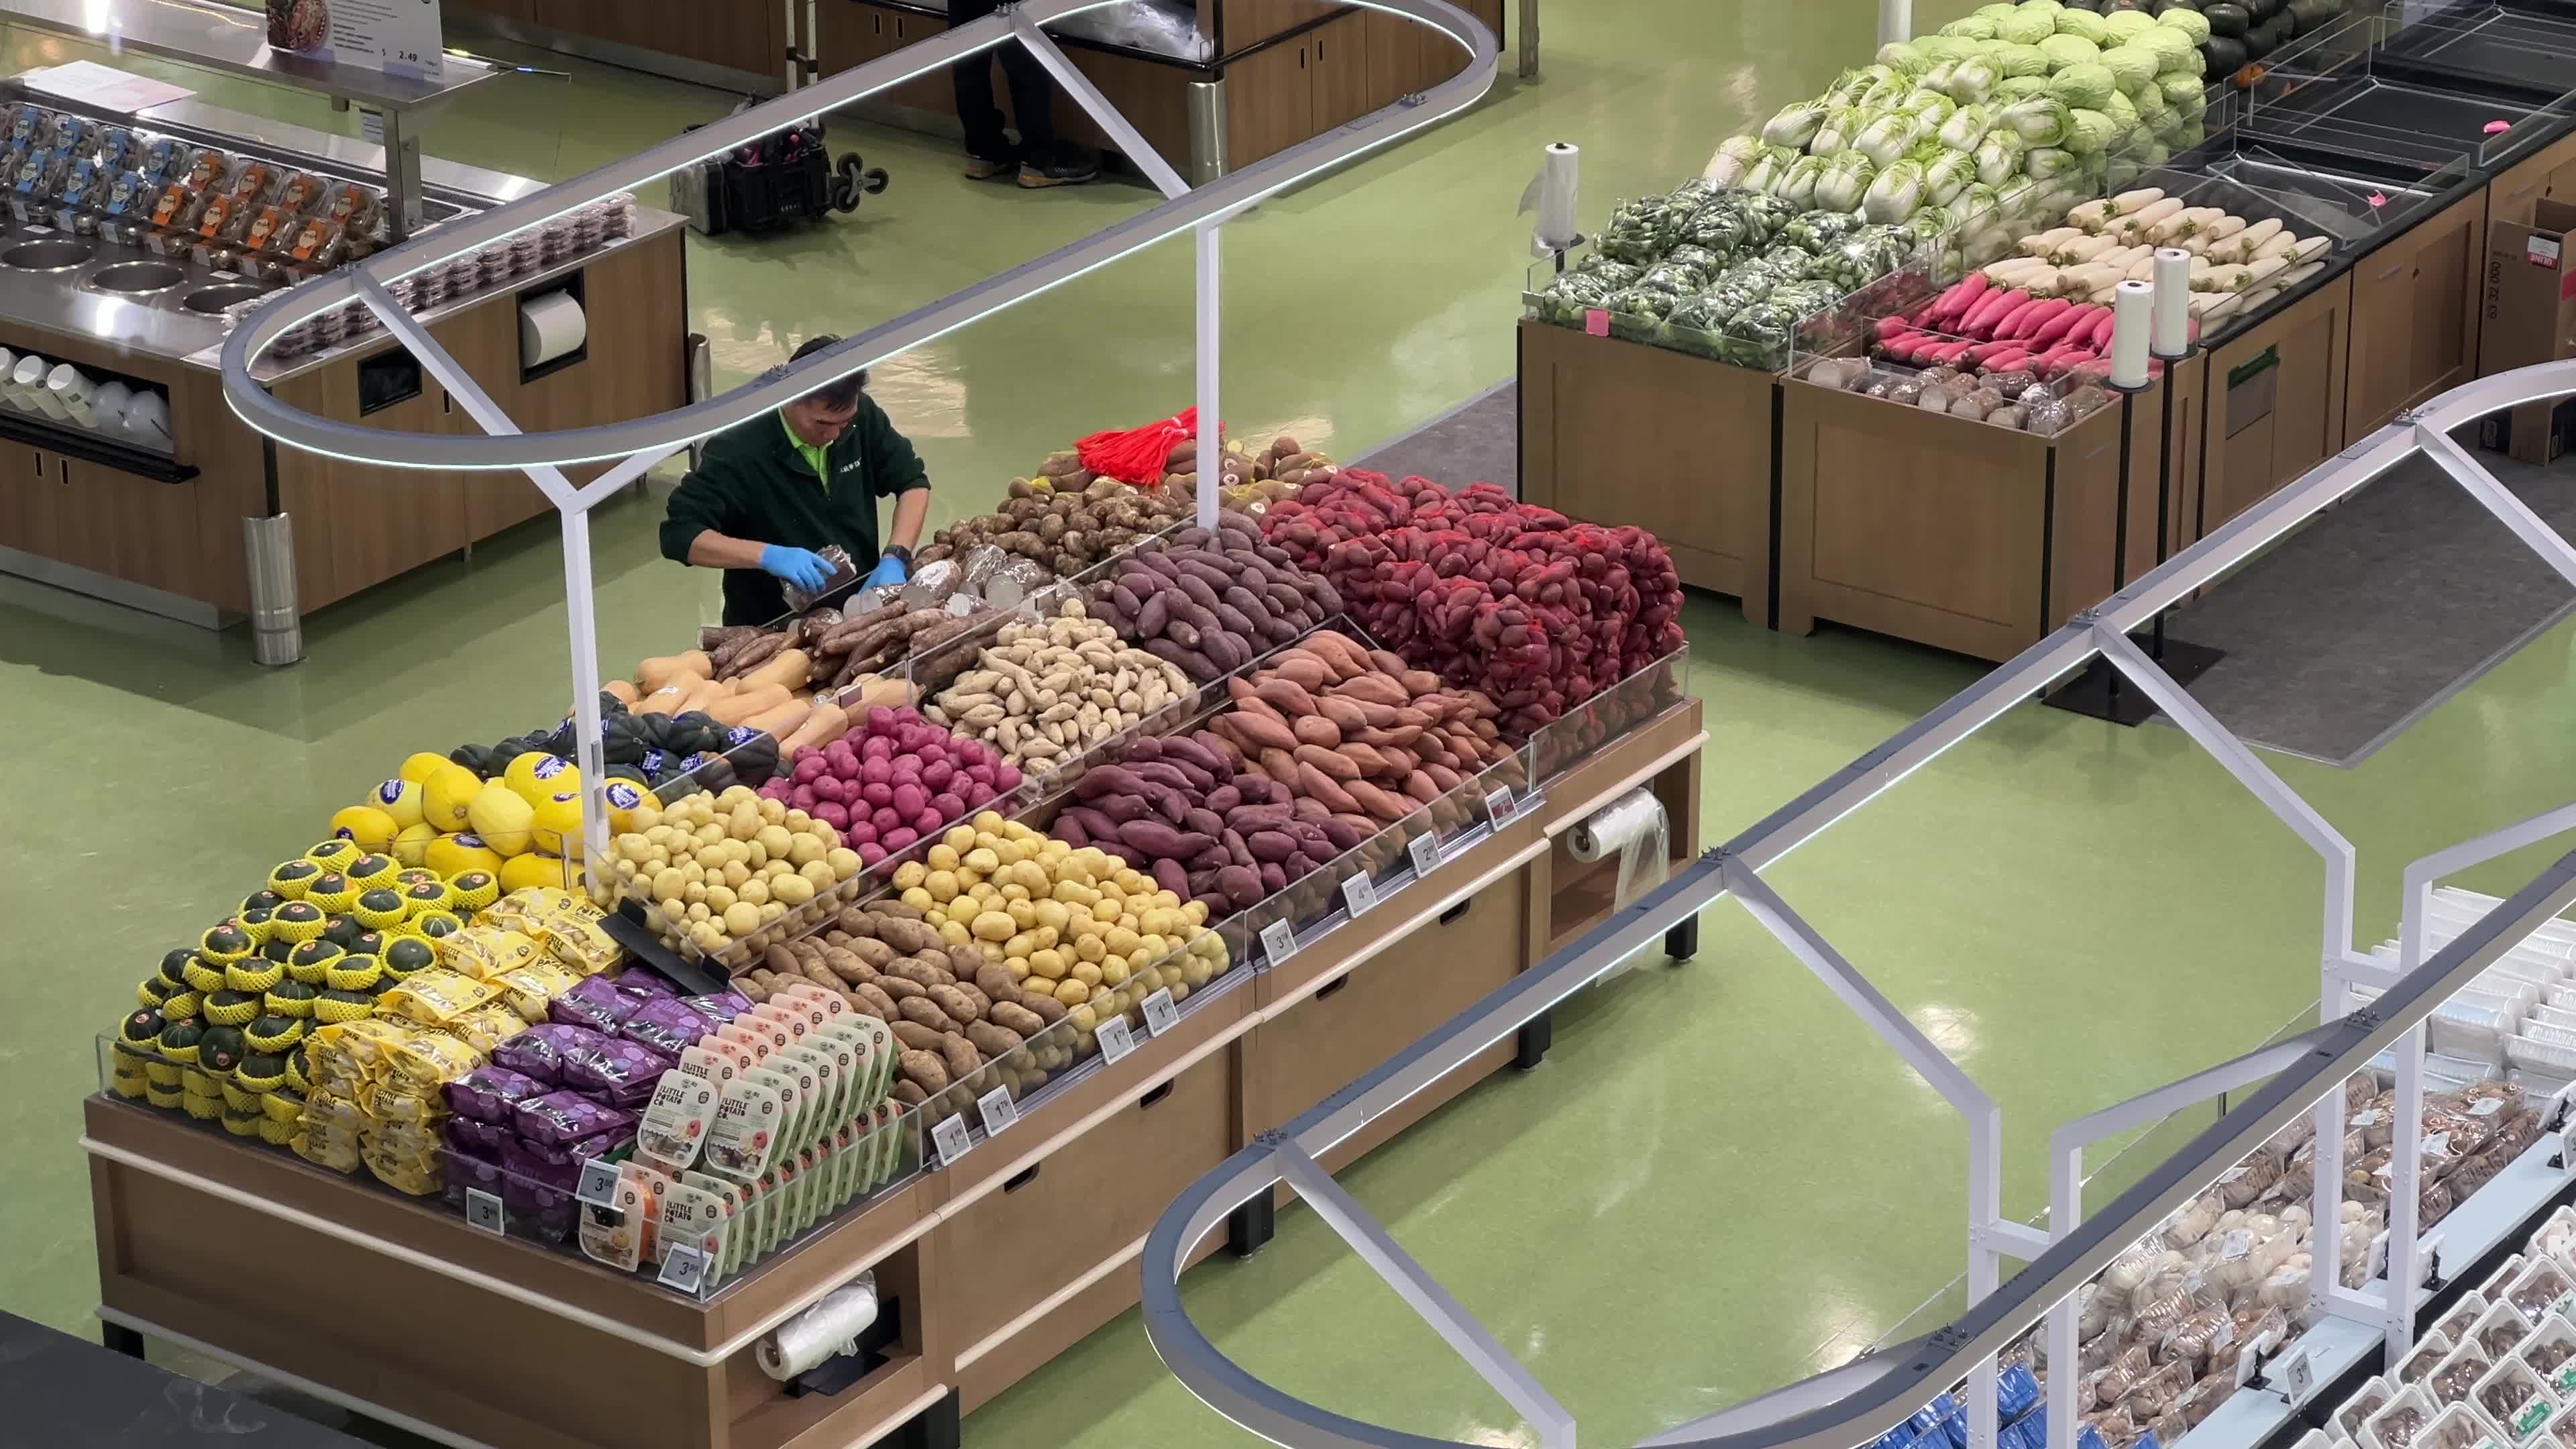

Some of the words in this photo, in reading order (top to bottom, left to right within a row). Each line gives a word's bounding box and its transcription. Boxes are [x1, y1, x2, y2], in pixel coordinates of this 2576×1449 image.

[399, 50, 418, 62] 2.49
[656, 1092, 682, 1105] POTATO
[719, 1104, 745, 1116] POTATO
